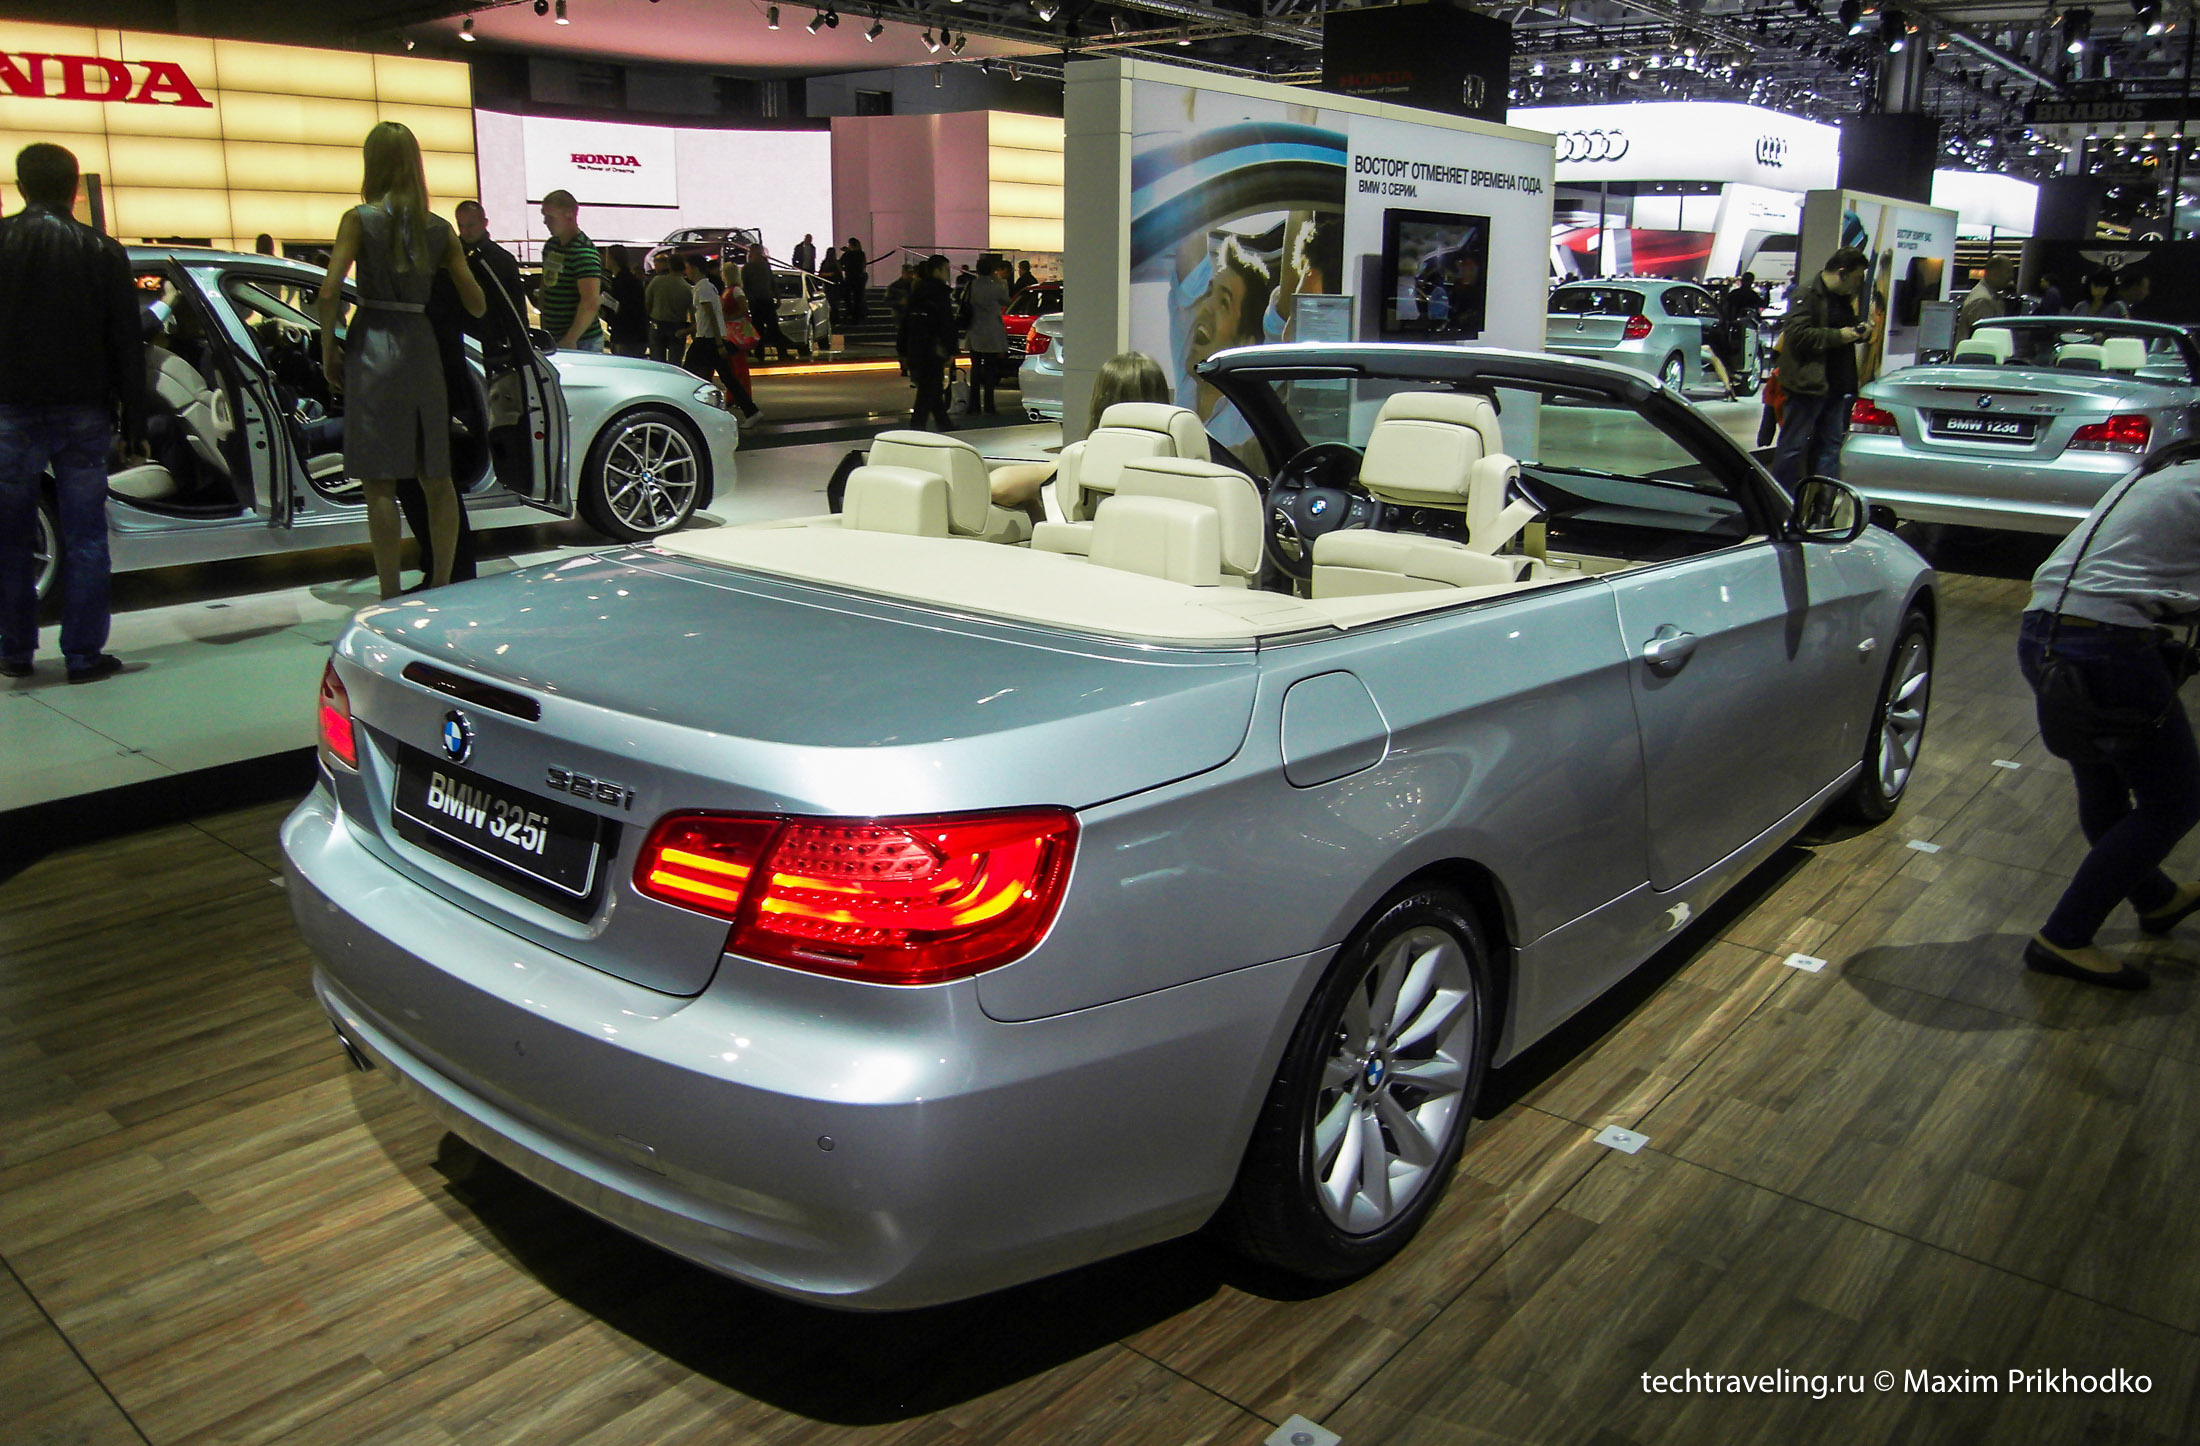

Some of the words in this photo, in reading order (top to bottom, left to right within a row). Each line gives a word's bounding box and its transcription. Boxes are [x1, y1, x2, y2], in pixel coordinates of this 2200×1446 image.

[2035, 102, 2143, 121] BRABUS
[570, 153, 641, 167] HONDA
[1355, 155, 1409, 178] ВОСТОРГ
[1411, 162, 1469, 185] ОТМЕНЯЕТ
[1471, 170, 1516, 190] ВРЕМЕНА
[1518, 175, 1543, 195] ГОДА.
[1359, 180, 1380, 193] BMW
[1381, 182, 1387, 194] 3
[1388, 182, 1418, 197] СЕРИИ.
[1947, 418, 1983, 431] BMW
[1986, 421, 2019, 433] 123d
[545, 763, 637, 812] 325i
[427, 771, 492, 829] BMW
[489, 799, 549, 855] 325i
